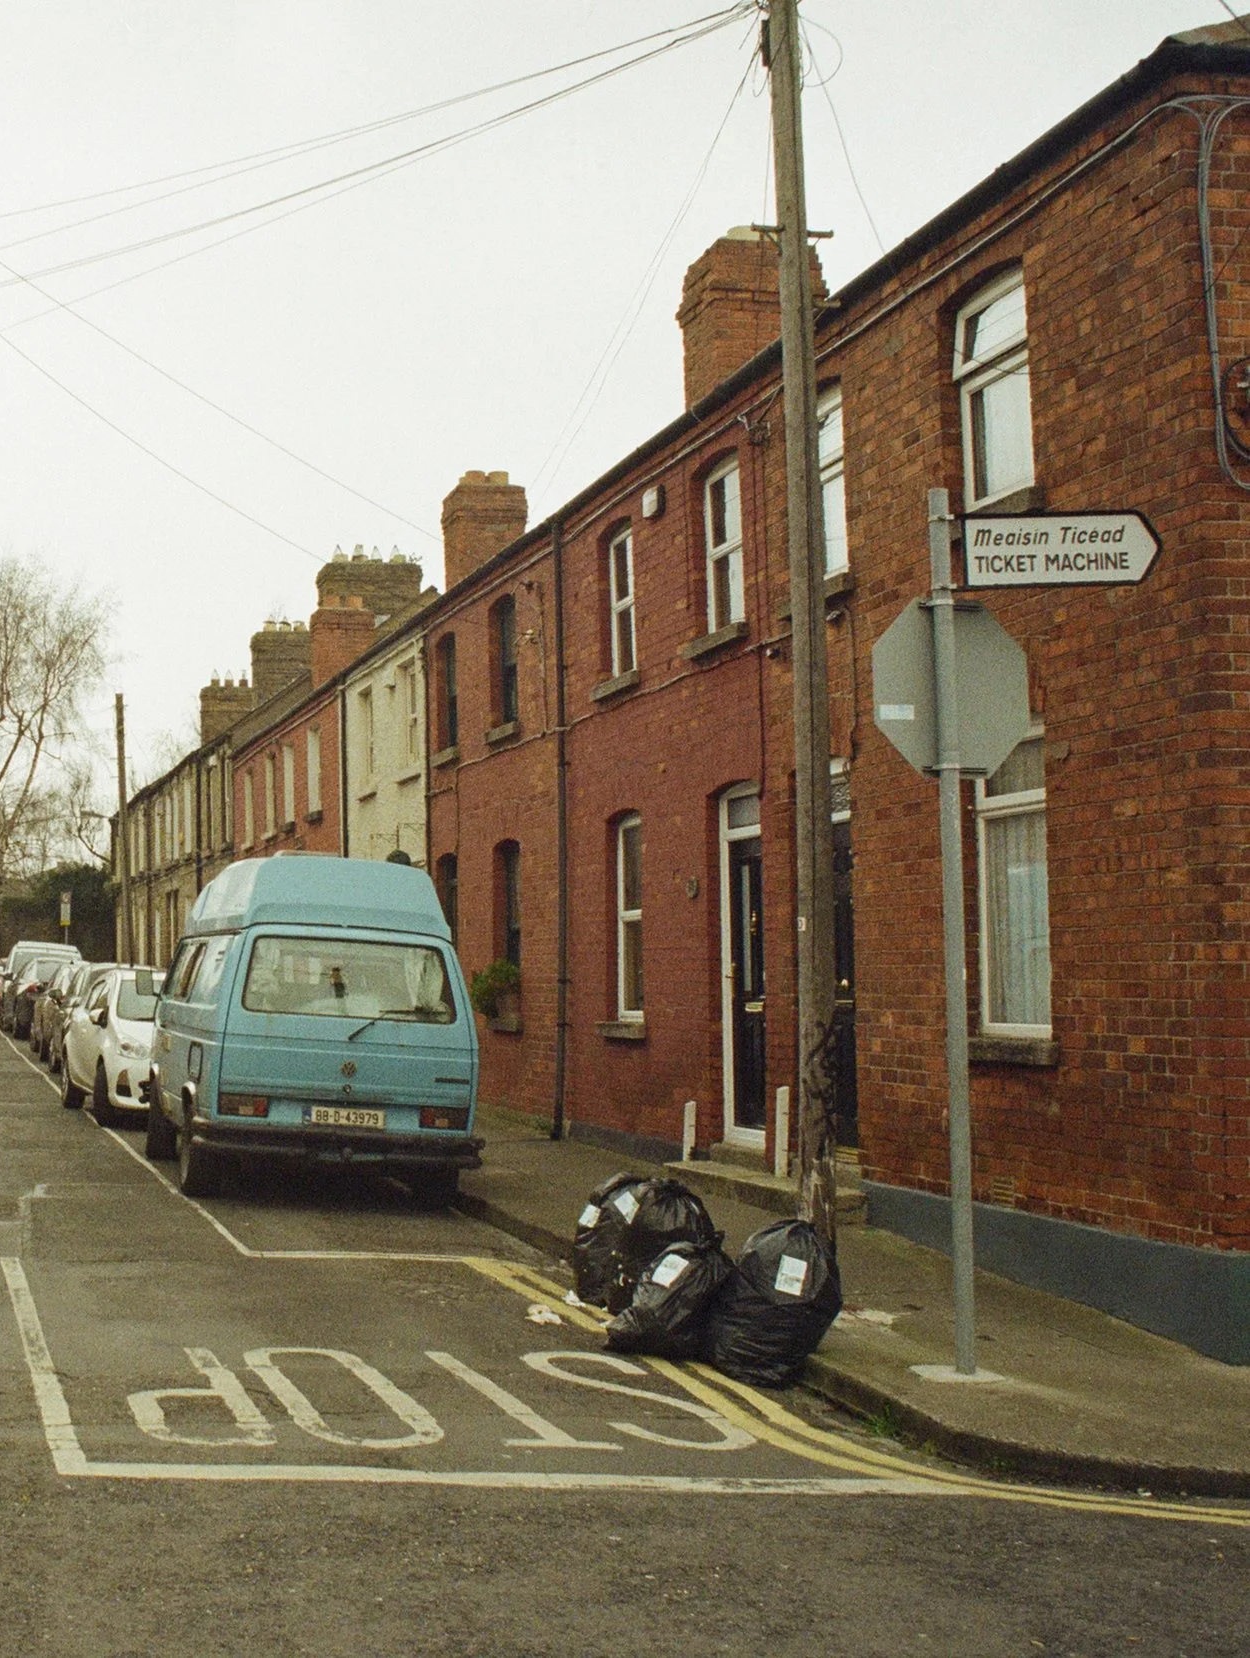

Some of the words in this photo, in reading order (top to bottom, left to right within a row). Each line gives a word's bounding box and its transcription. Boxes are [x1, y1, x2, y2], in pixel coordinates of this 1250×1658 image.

[1060, 525, 1125, 544] Ticéad
[975, 554, 1037, 573] TICKET
[1045, 552, 1130, 572] MACHINE
[126, 1346, 758, 1451] STOP
